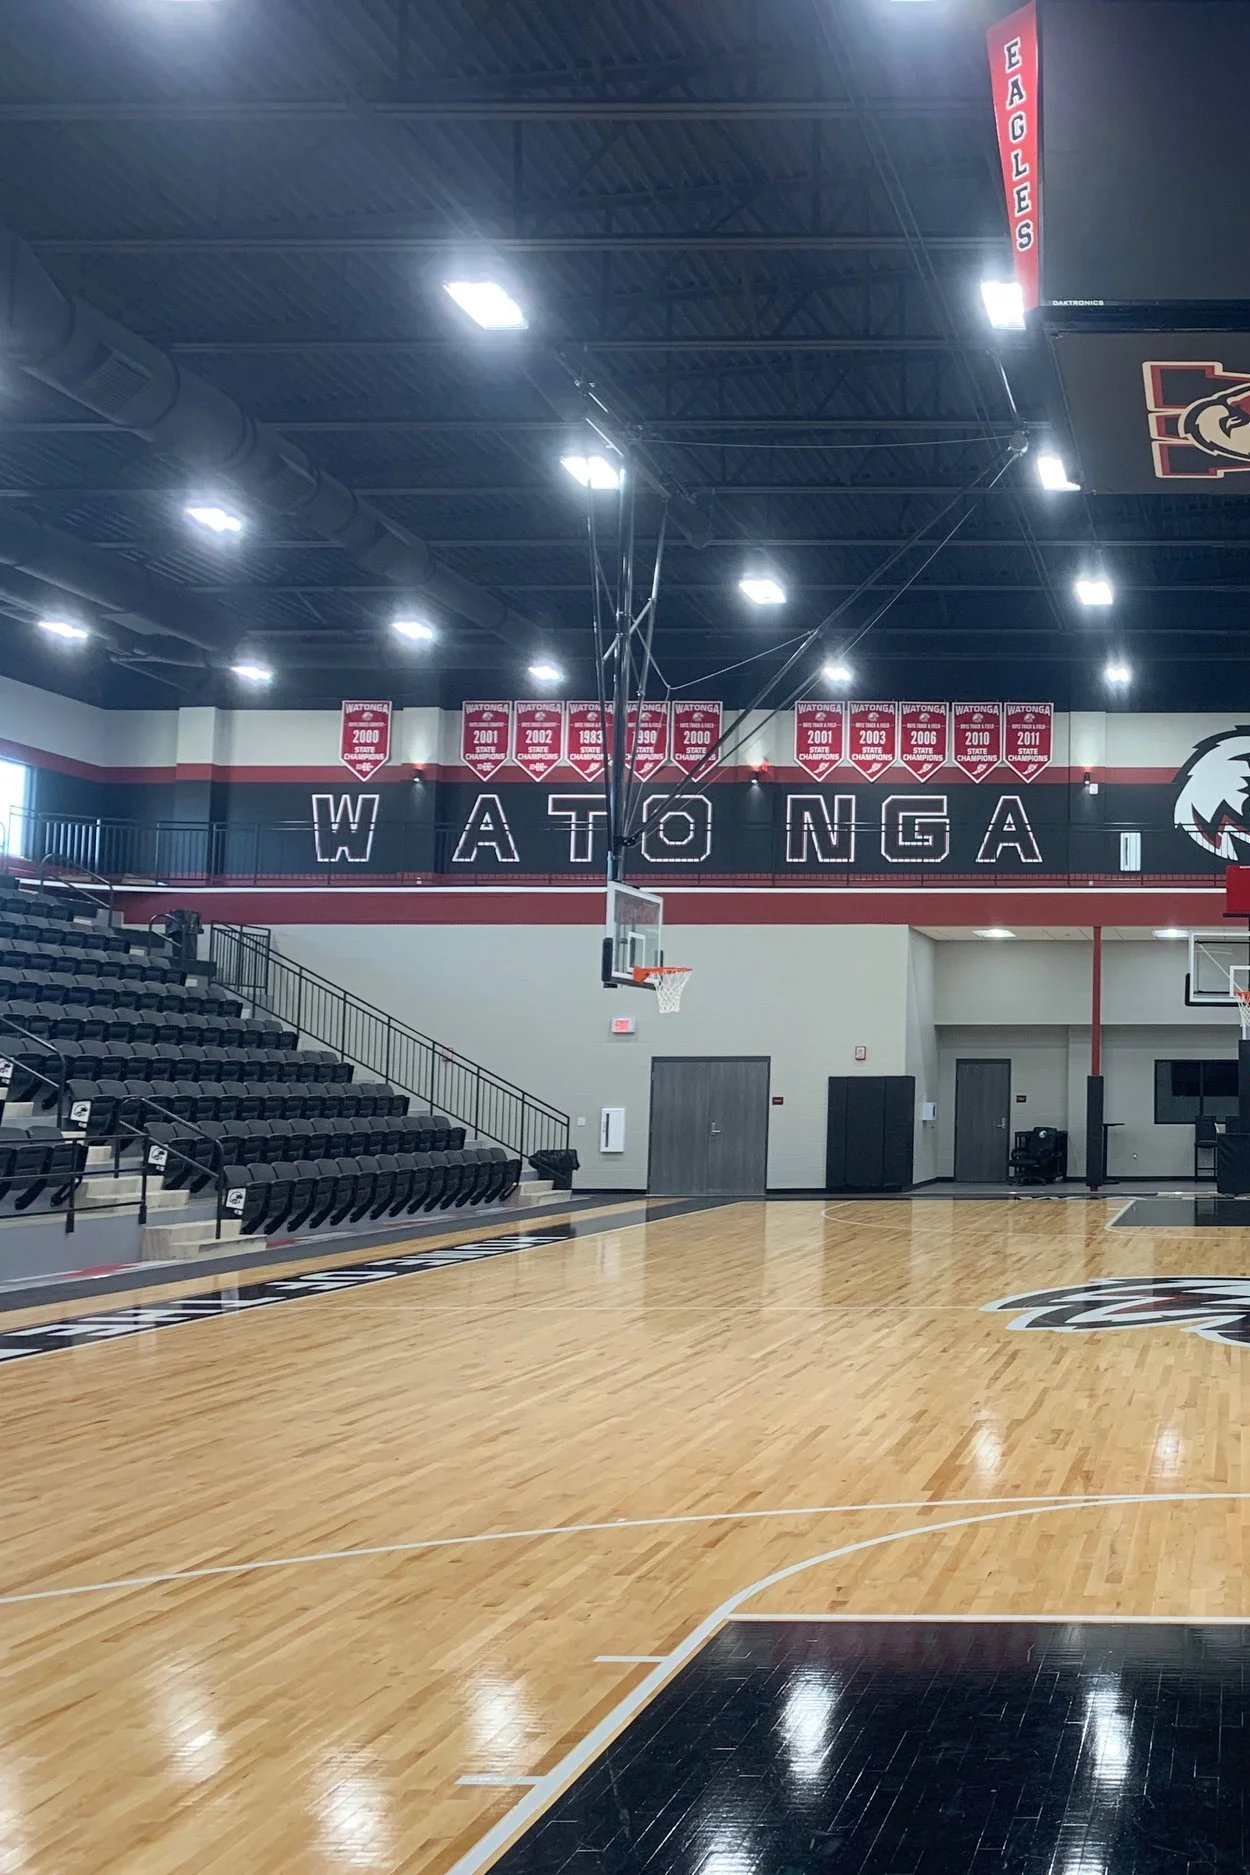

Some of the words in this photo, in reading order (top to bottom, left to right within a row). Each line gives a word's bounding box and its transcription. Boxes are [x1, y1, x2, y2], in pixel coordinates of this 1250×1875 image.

[1003, 36, 1034, 251] EAGLES
[346, 703, 389, 714] WATONGA
[465, 704, 508, 714] WATONGA
[518, 704, 560, 714] WATONGA
[676, 704, 719, 714] WATONGA
[799, 704, 841, 714] WATONGA
[851, 704, 894, 714] WATONGA
[903, 705, 945, 715] WATONGA
[956, 705, 998, 715] WATONGA
[1008, 705, 1050, 716] WATONGA
[353, 730, 379, 743] 2000
[473, 730, 498, 743] 2001
[525, 730, 552, 743] 2002
[579, 730, 603, 743] 1983
[684, 731, 710, 744] 2000
[808, 731, 832, 743] 2001
[860, 731, 885, 744] 2003
[911, 731, 936, 744] 2006
[965, 732, 989, 745] 2010
[1017, 732, 1039, 745] 2011
[311, 794, 1043, 862] WATONGA
